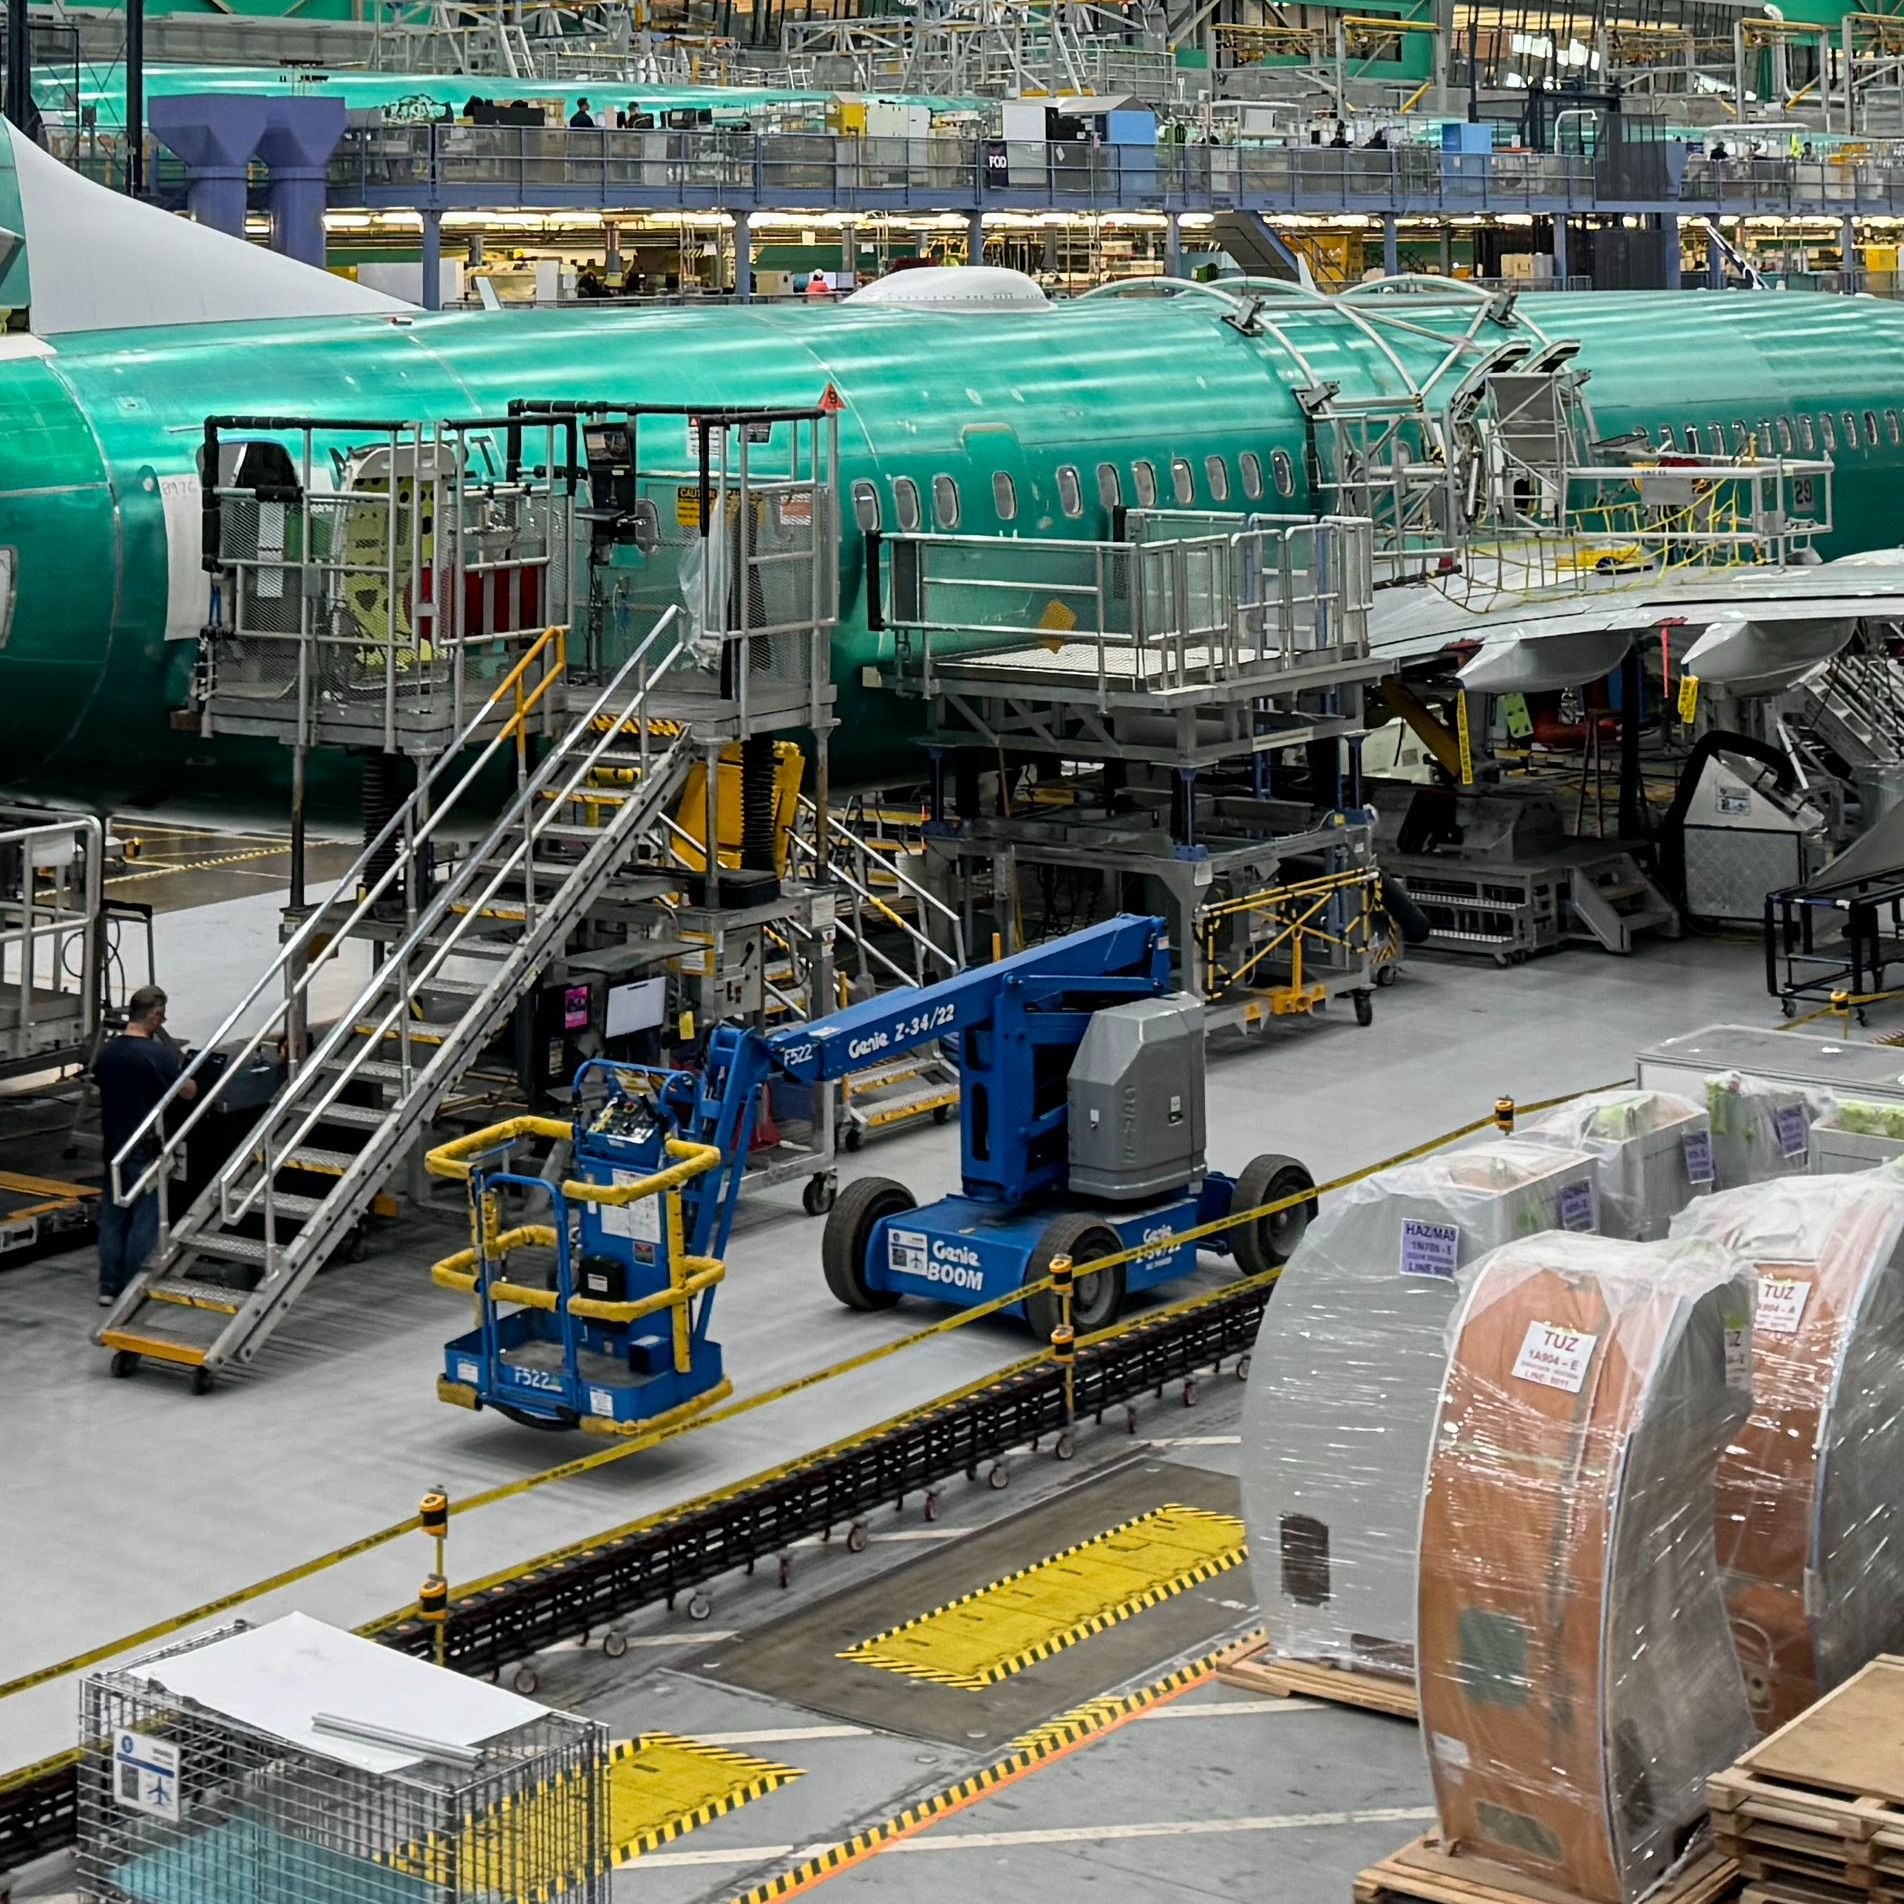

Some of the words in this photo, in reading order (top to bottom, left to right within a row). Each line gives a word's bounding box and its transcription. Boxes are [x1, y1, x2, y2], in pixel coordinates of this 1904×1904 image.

[1794, 479, 1812, 504] 29
[848, 1031, 890, 1059] Genie
[894, 1003, 955, 1042] Z-34/22
[784, 1043, 814, 1068] F522
[933, 1240, 981, 1267] Genie
[927, 1261, 984, 1291] BOOM
[1764, 1283, 1796, 1300] TUZ
[1544, 1330, 1580, 1352] TUZ
[514, 1365, 550, 1388] F522
